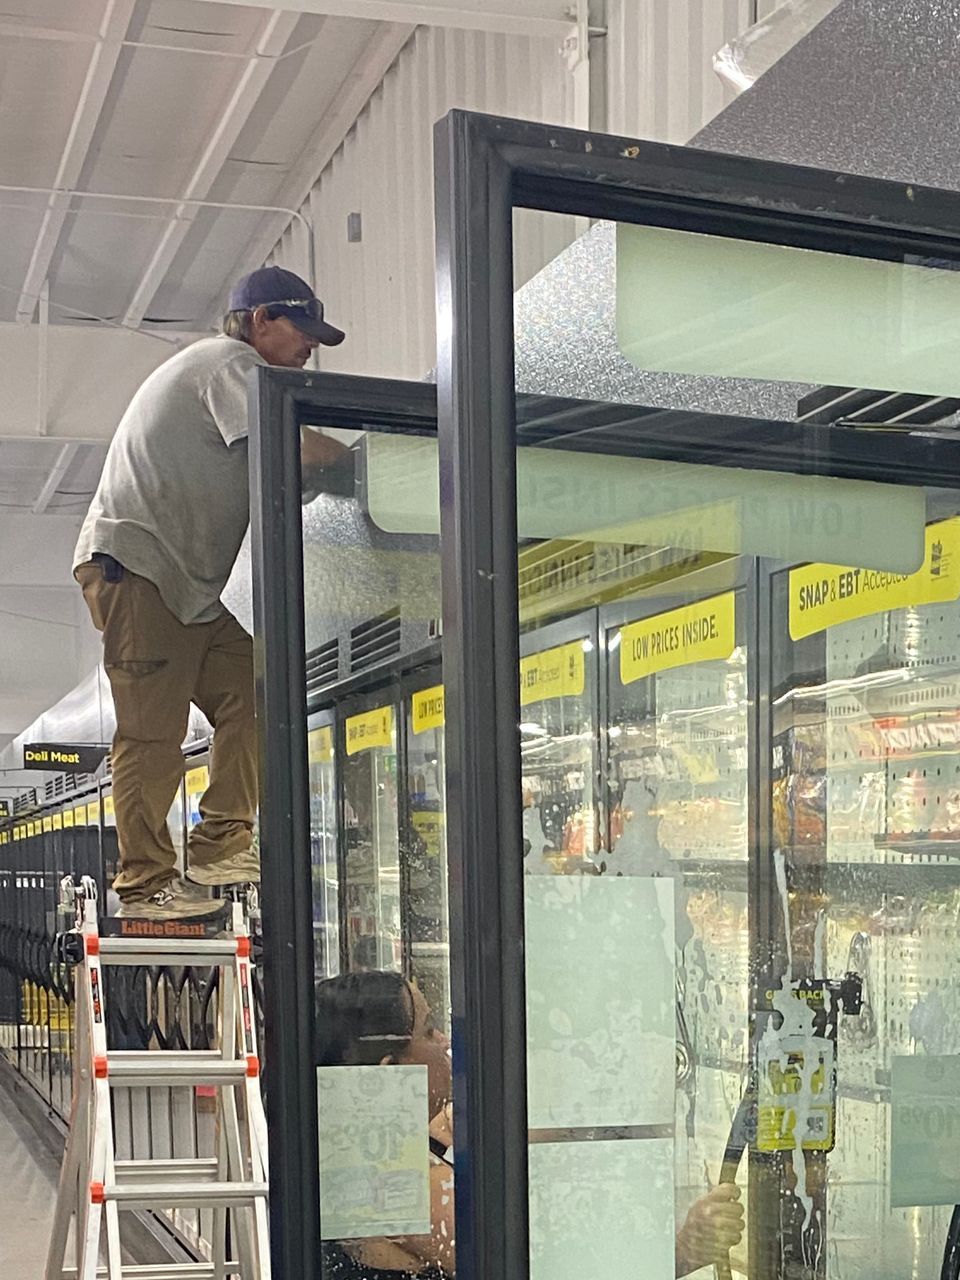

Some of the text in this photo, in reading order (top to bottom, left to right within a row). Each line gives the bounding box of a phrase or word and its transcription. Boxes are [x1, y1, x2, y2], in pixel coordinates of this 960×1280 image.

[799, 579, 830, 612] SNAP
[830, 578, 837, 602] &
[838, 569, 861, 600] EBT
[632, 614, 719, 662] LOW PRICES INSIDE.
[25, 751, 80, 764] Deli Meat
